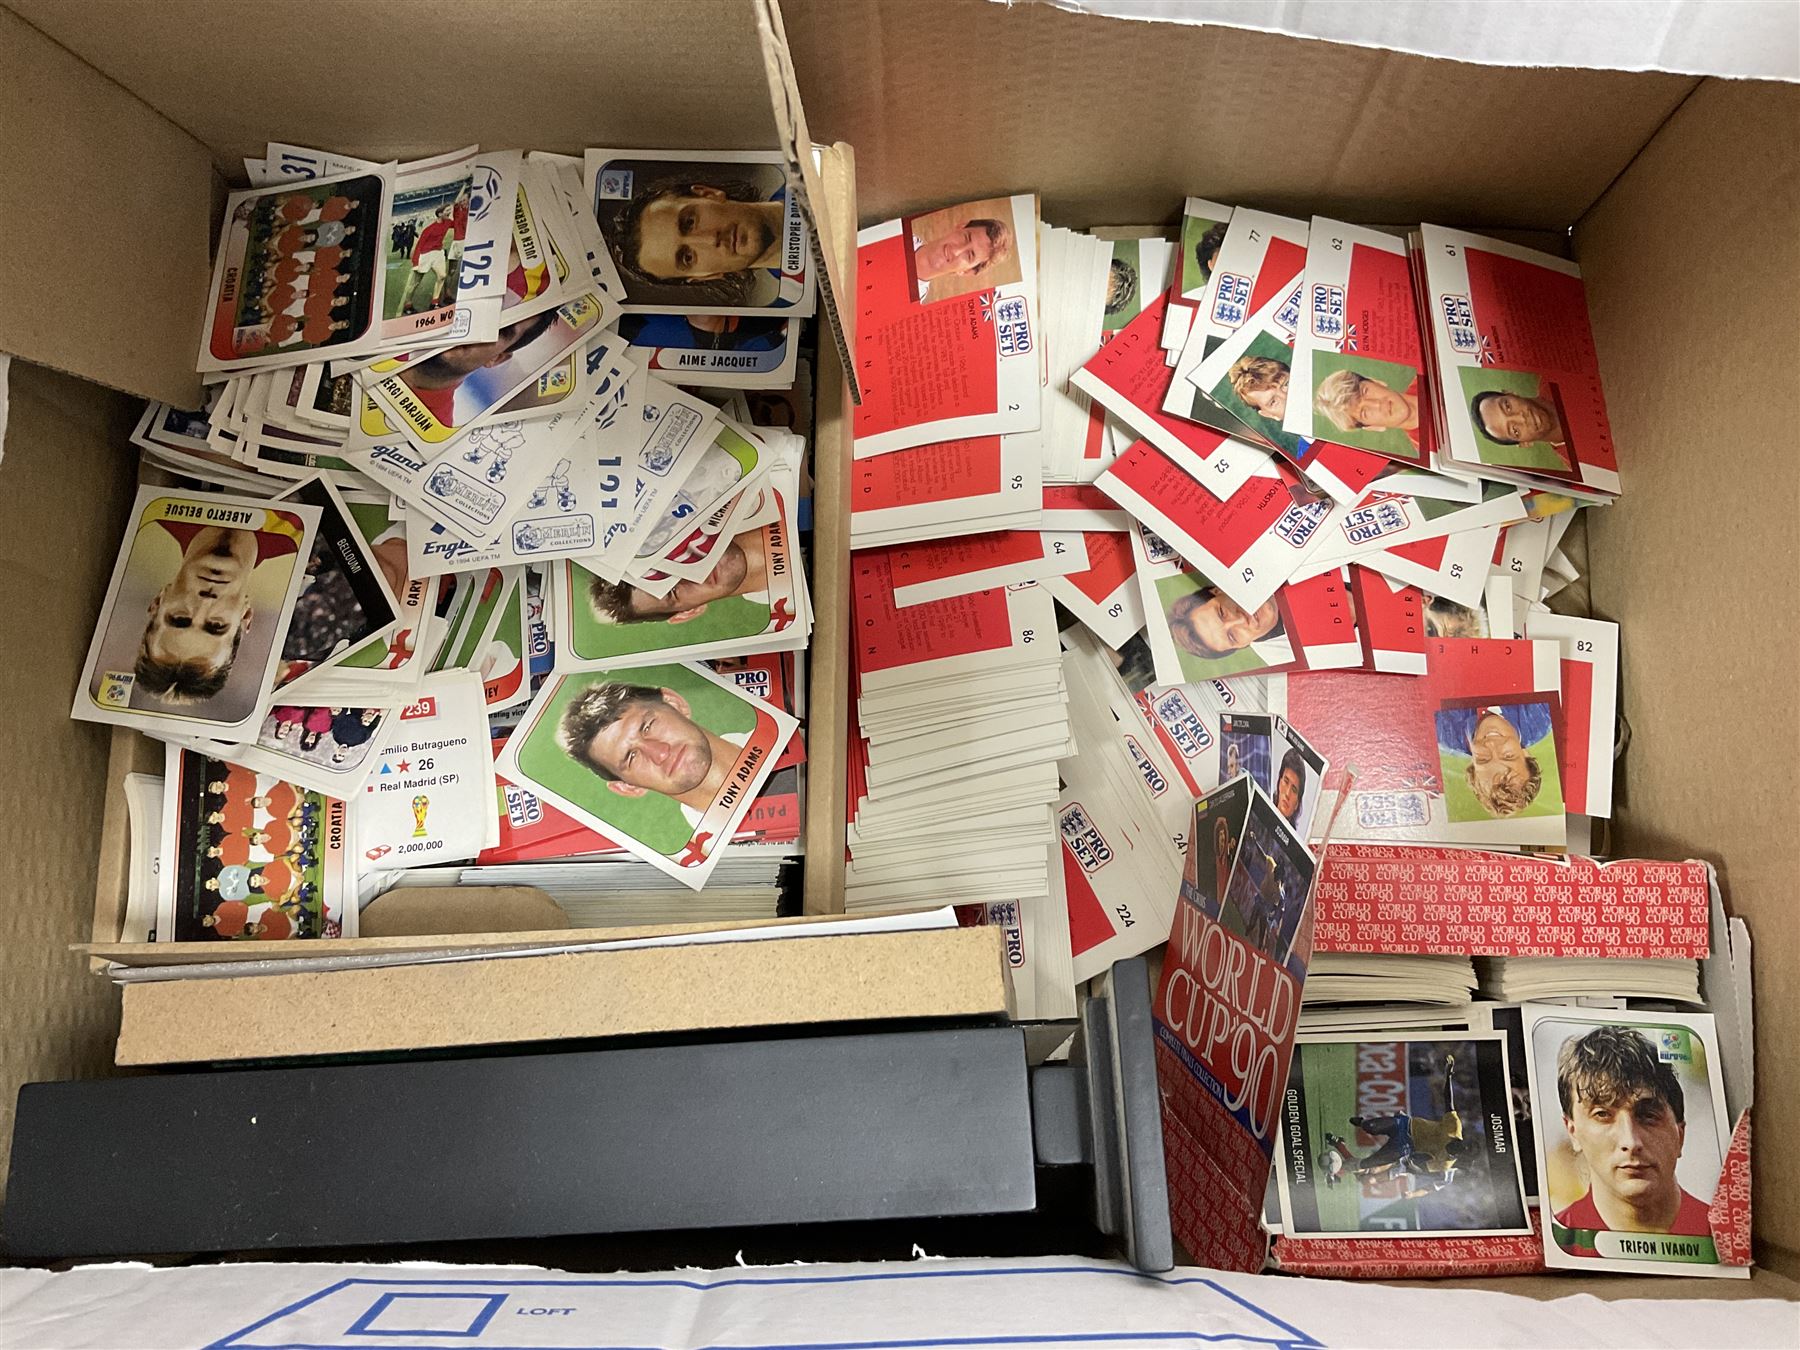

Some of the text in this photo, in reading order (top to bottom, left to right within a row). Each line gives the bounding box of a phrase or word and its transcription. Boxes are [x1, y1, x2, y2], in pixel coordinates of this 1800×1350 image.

[787, 218, 801, 271] CHRISTOPHE
[1249, 229, 1261, 243] 77
[1332, 237, 1343, 251] 62
[523, 236, 538, 261] JULEN
[1446, 244, 1456, 257] 61
[458, 240, 494, 290] 125
[1218, 274, 1235, 302] PRO
[1234, 278, 1250, 306] SET
[1314, 286, 1327, 313] PRO
[1329, 288, 1343, 316] SET
[415, 315, 436, 329] 1966
[1443, 296, 1460, 326] PRO
[1457, 298, 1473, 328] SET
[999, 324, 1015, 353] SET
[1013, 320, 1030, 351] PRO
[679, 354, 758, 368] AIME JACQUET
[399, 397, 434, 433] BARJUÁN
[1008, 403, 1020, 412] 2
[1213, 458, 1230, 474] 52
[1012, 475, 1023, 490] 95
[455, 497, 491, 521] COLLECTIONS
[1257, 485, 1280, 512] FORSYTH
[164, 503, 253, 524] ALBERTO BELSUÉ
[1280, 505, 1304, 536] SET
[1343, 508, 1377, 530] SET
[1291, 514, 1318, 546] PRO
[1349, 522, 1383, 544] PRO
[549, 537, 592, 546] COLLECTIONS
[770, 521, 786, 577] TONY ADAM
[1053, 541, 1066, 555] 64
[337, 537, 362, 574] BELLOUMI
[1512, 557, 1522, 573] 53
[1241, 567, 1255, 583] 67
[1450, 563, 1463, 580] 85
[406, 579, 423, 607] GARY
[1108, 602, 1123, 618] 60
[532, 623, 548, 654] PRO
[1022, 629, 1035, 643] 86
[1576, 640, 1593, 653] 82
[734, 671, 769, 685] PRO
[406, 701, 430, 717] 239
[1169, 722, 1199, 758] SET
[1183, 712, 1213, 748] PRO
[411, 737, 467, 754] Butragueno
[418, 758, 435, 771] 26
[380, 773, 460, 792] Real Madrid (SP)
[718, 745, 764, 810] TONY ADAMS
[1138, 760, 1167, 793] PRO
[507, 793, 525, 824] SET
[524, 789, 541, 822] PRO
[329, 800, 343, 850] CROATIA
[397, 839, 444, 855] 2,000,000
[1070, 837, 1098, 871] SET
[1083, 827, 1112, 861] PRO
[1331, 863, 1370, 872] WORLD
[1376, 863, 1414, 872] WORLD
[1355, 883, 1393, 892] WORLD
[1400, 883, 1438, 893] WORLD
[1444, 884, 1482, 893] WORLD
[1488, 885, 1527, 894] WORLD
[1534, 886, 1572, 895] WORLD
[1578, 886, 1617, 896] WORLD
[1623, 886, 1661, 896] WORLD
[1667, 887, 1705, 896] WORLD
[1115, 904, 1136, 928] 224
[1006, 928, 1023, 965] PRO
[1182, 902, 1294, 1045] WORLD
[1193, 1059, 1224, 1099] COLLECTION
[1286, 1088, 1306, 1185] GOLDEN GOAL SPECIAL
[1490, 1113, 1507, 1154] JOSIMAR
[1619, 1239, 1700, 1257] TRIFON IVANOV
[515, 1306, 578, 1317] LOFT
